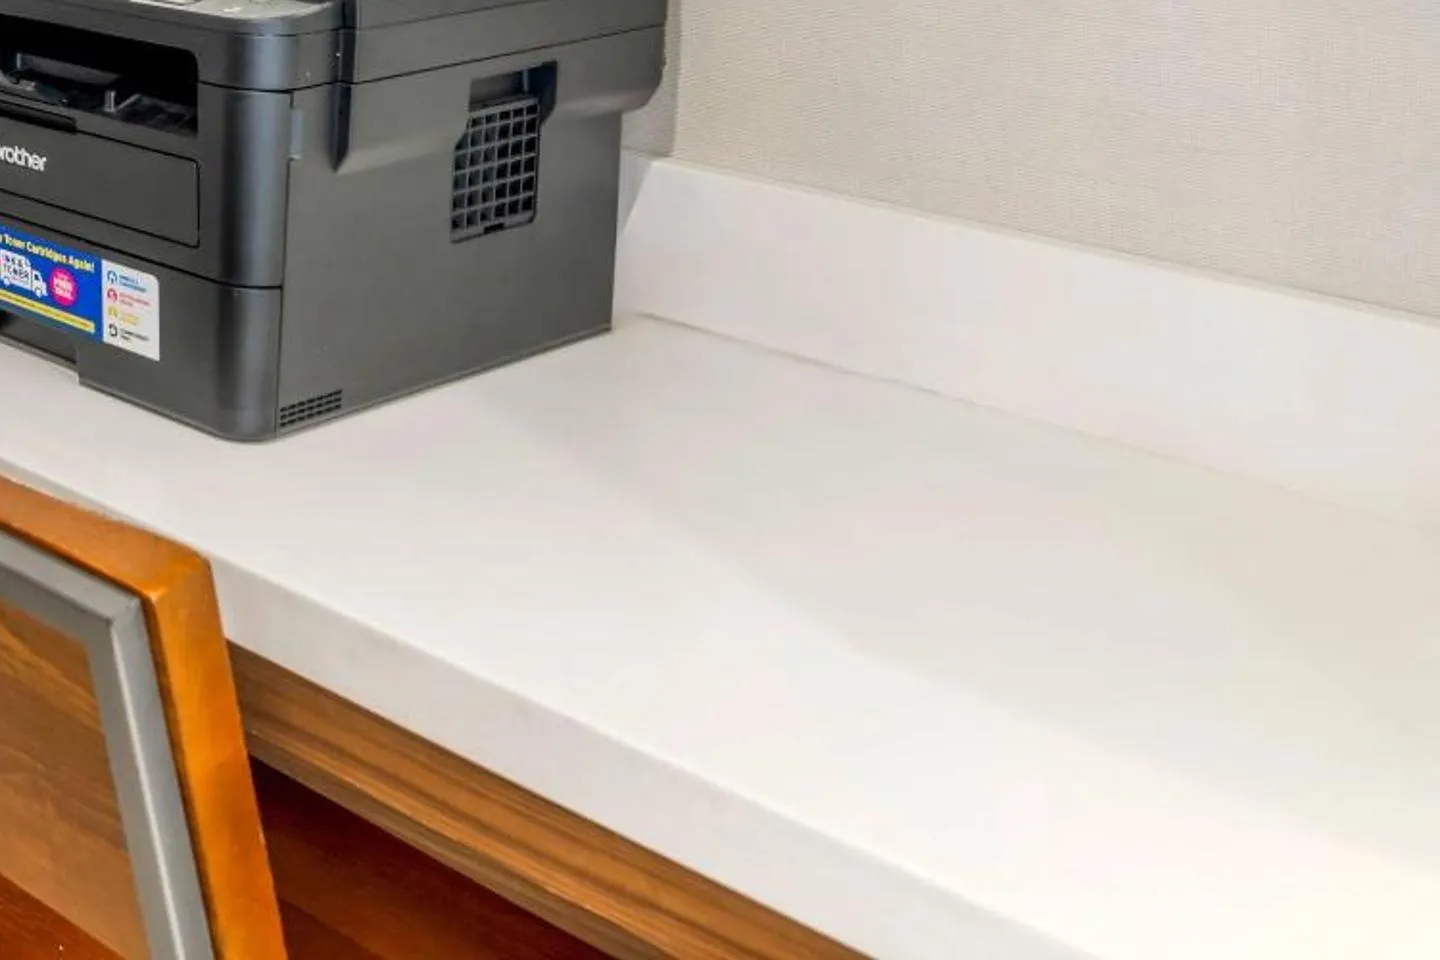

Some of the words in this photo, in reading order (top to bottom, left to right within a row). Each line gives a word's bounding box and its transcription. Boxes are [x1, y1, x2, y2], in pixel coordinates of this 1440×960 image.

[4, 234, 26, 249] Toner
[26, 242, 67, 263] Cartridges
[68, 255, 95, 273] Again!
[3, 263, 29, 279] TONER
